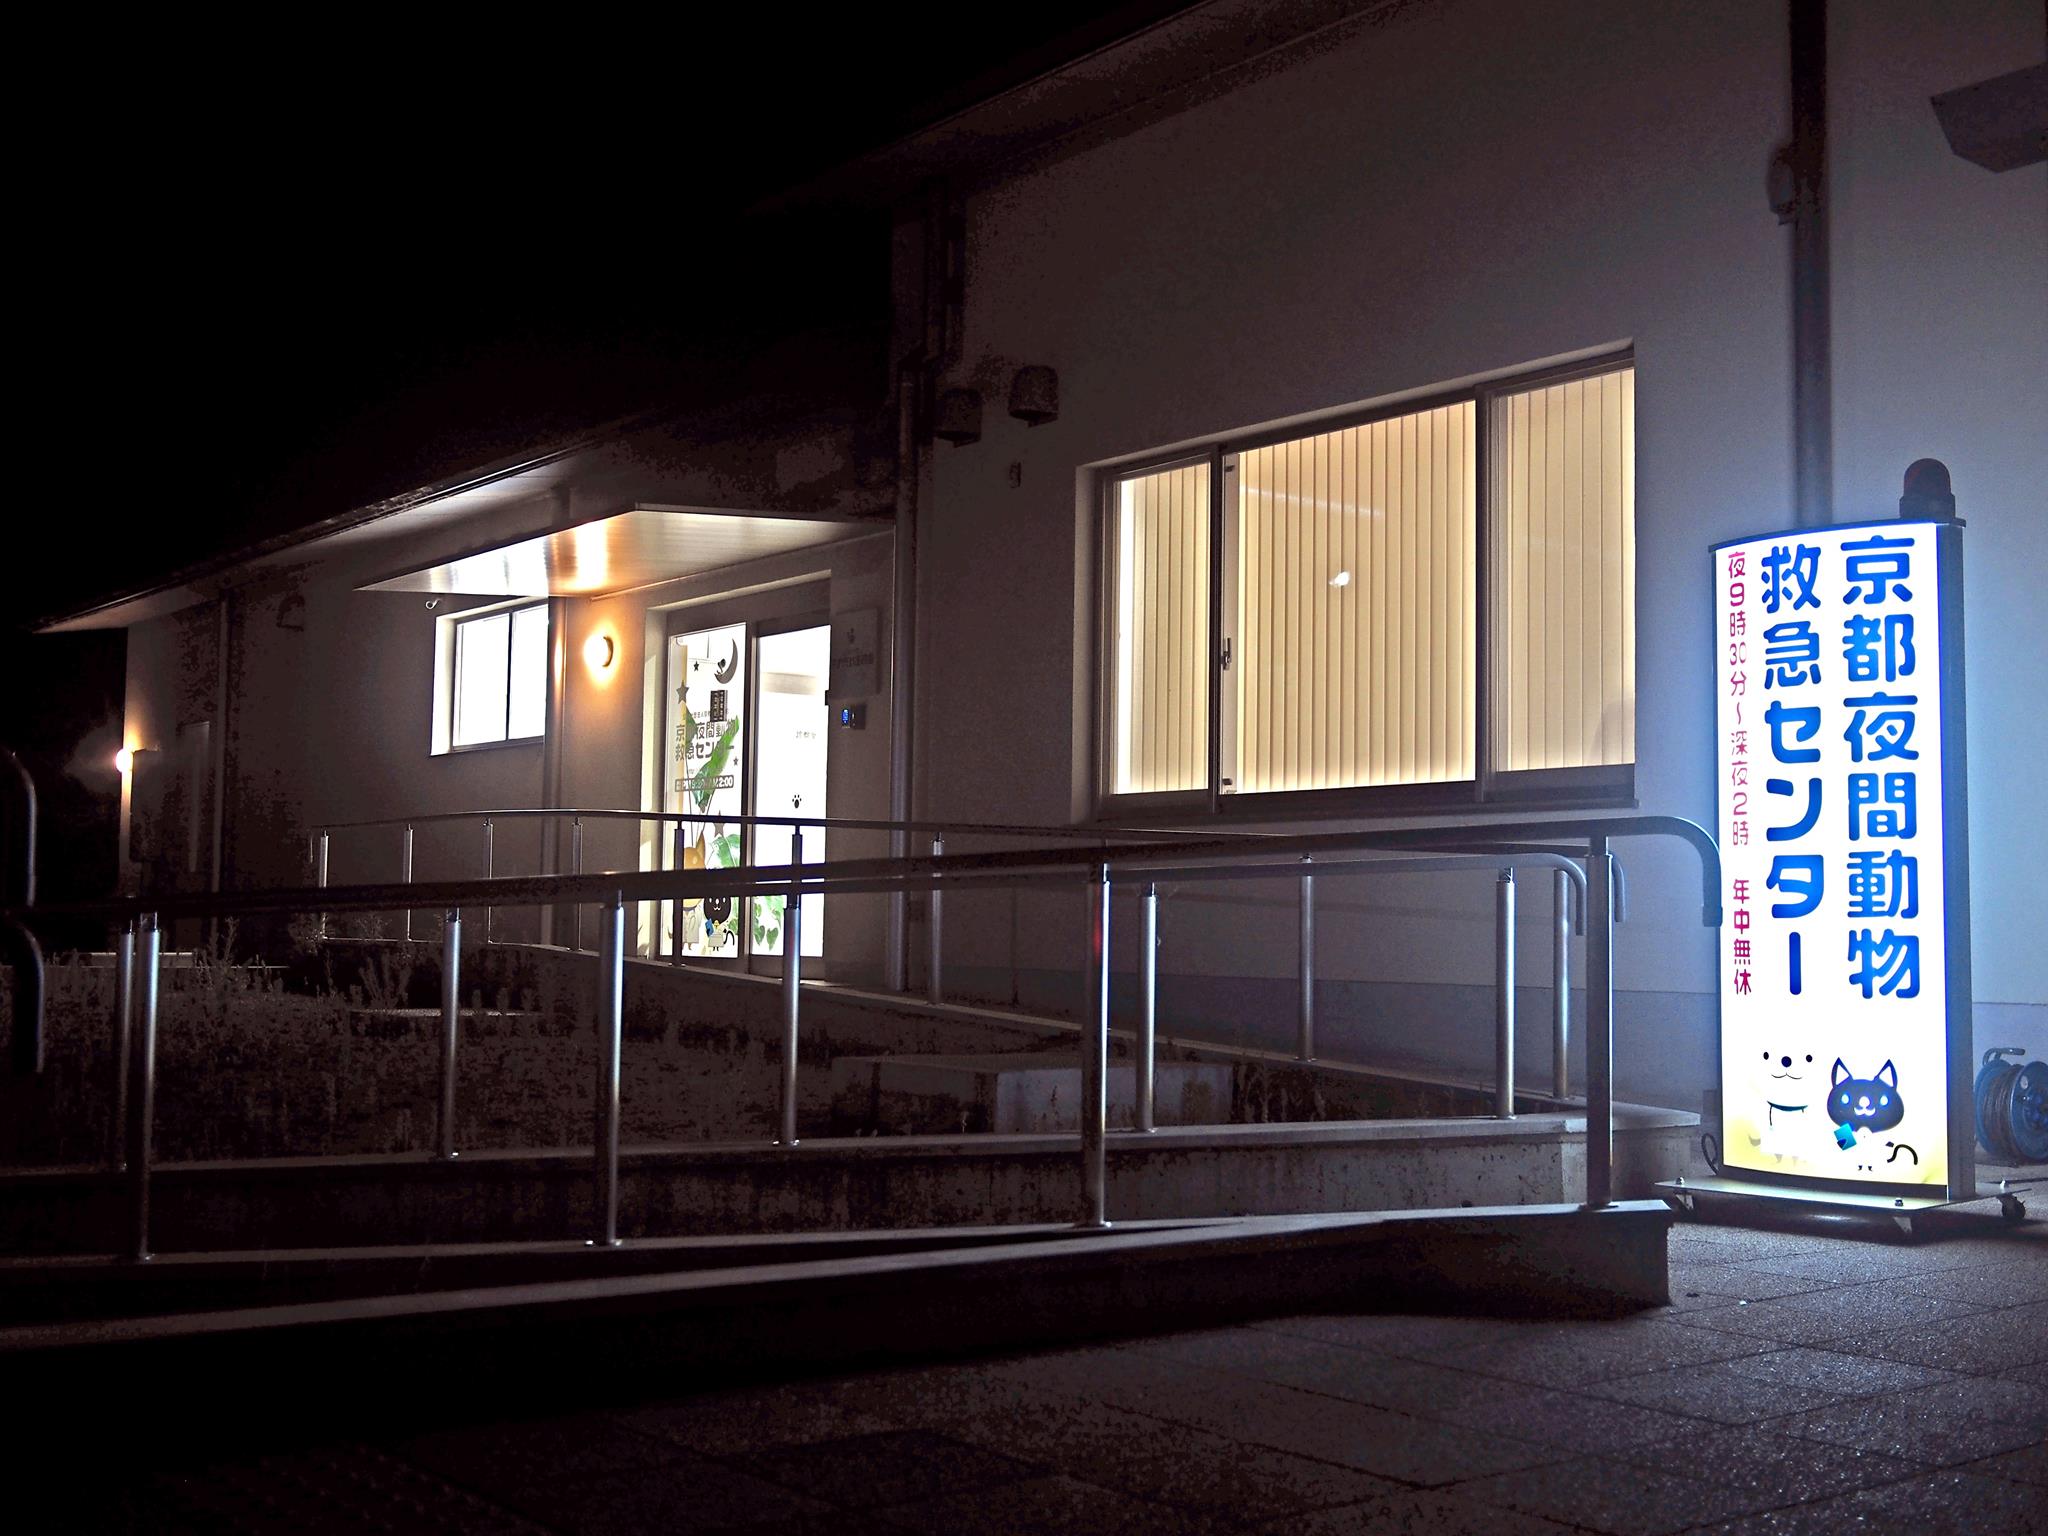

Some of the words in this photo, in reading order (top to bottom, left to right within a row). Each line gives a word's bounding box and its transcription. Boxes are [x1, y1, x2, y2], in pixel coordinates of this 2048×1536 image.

[1733, 879, 1753, 997] 年中無休
[1760, 545, 1826, 997] 救急センター
[1840, 535, 1922, 1001] 京都夜間動物
